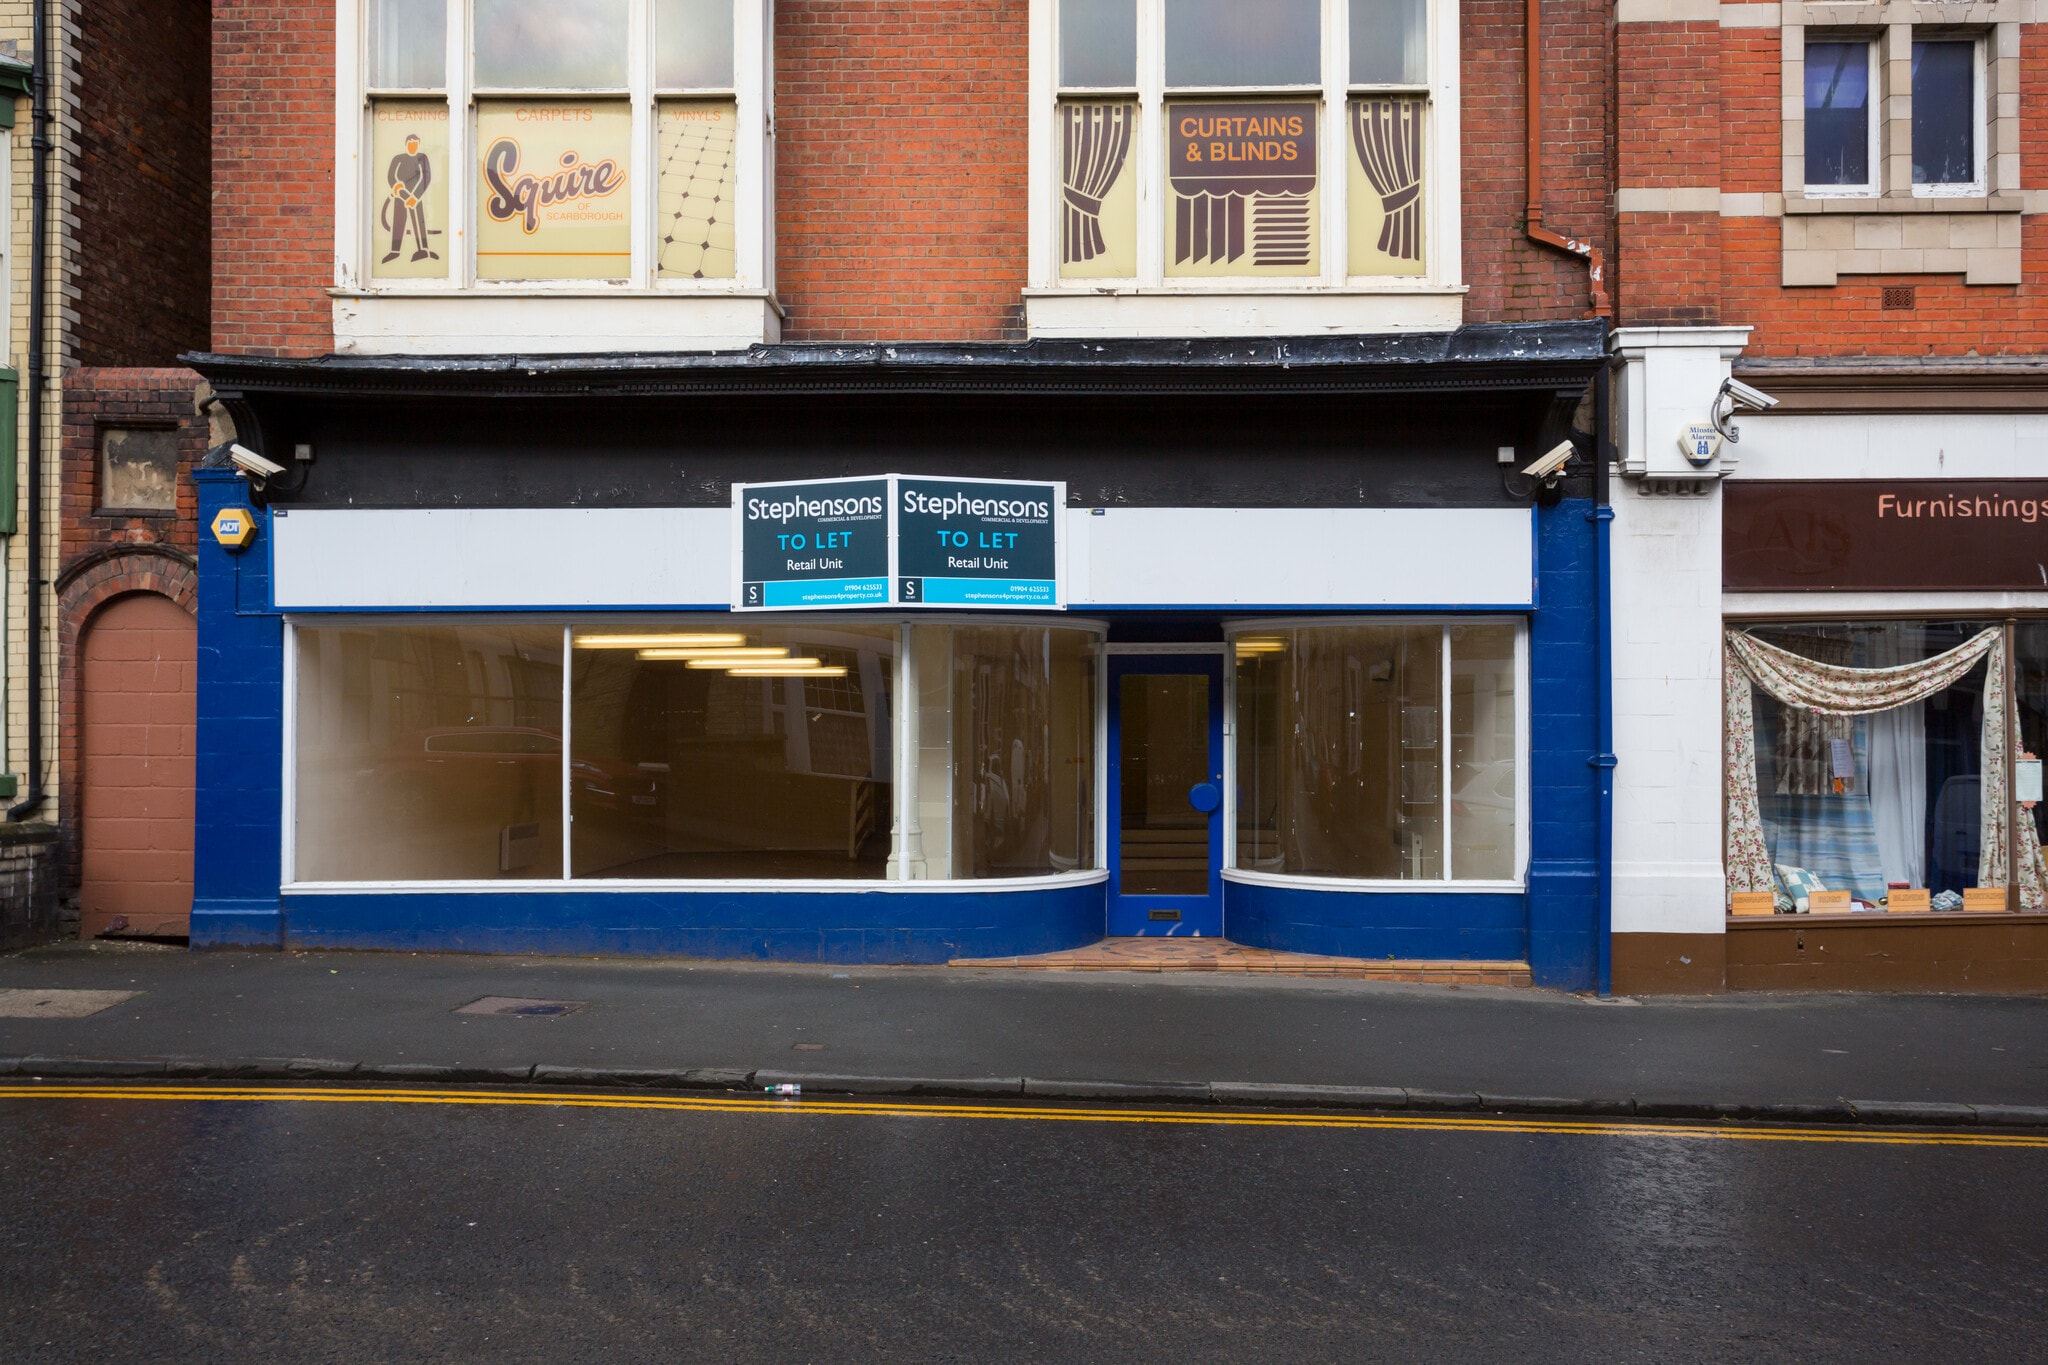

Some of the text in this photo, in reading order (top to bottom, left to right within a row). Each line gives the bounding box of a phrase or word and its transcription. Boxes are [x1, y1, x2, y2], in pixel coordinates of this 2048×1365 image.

[377, 109, 448, 121] CLEANING
[515, 108, 593, 122] CARPETS
[673, 110, 721, 121] VINYLS
[1180, 116, 1303, 137] CURTAINS
[1186, 141, 1298, 162] & BLINDS
[484, 138, 625, 233] Squire
[577, 202, 591, 211] OF
[546, 212, 623, 221] SCARBOROUGH
[748, 495, 882, 524] Stephensons
[904, 490, 1049, 520] Stephensons
[220, 522, 240, 532] ADT
[777, 531, 853, 550] TO LET
[937, 530, 1018, 549] TO LET
[787, 557, 843, 571] Retail Unit
[948, 556, 1009, 570] Retail Unit
[749, 586, 757, 600] S
[906, 581, 914, 595] S
[802, 591, 882, 601] stephensons4property.co.uk
[965, 592, 1049, 601] stephensons4property.co.uk
